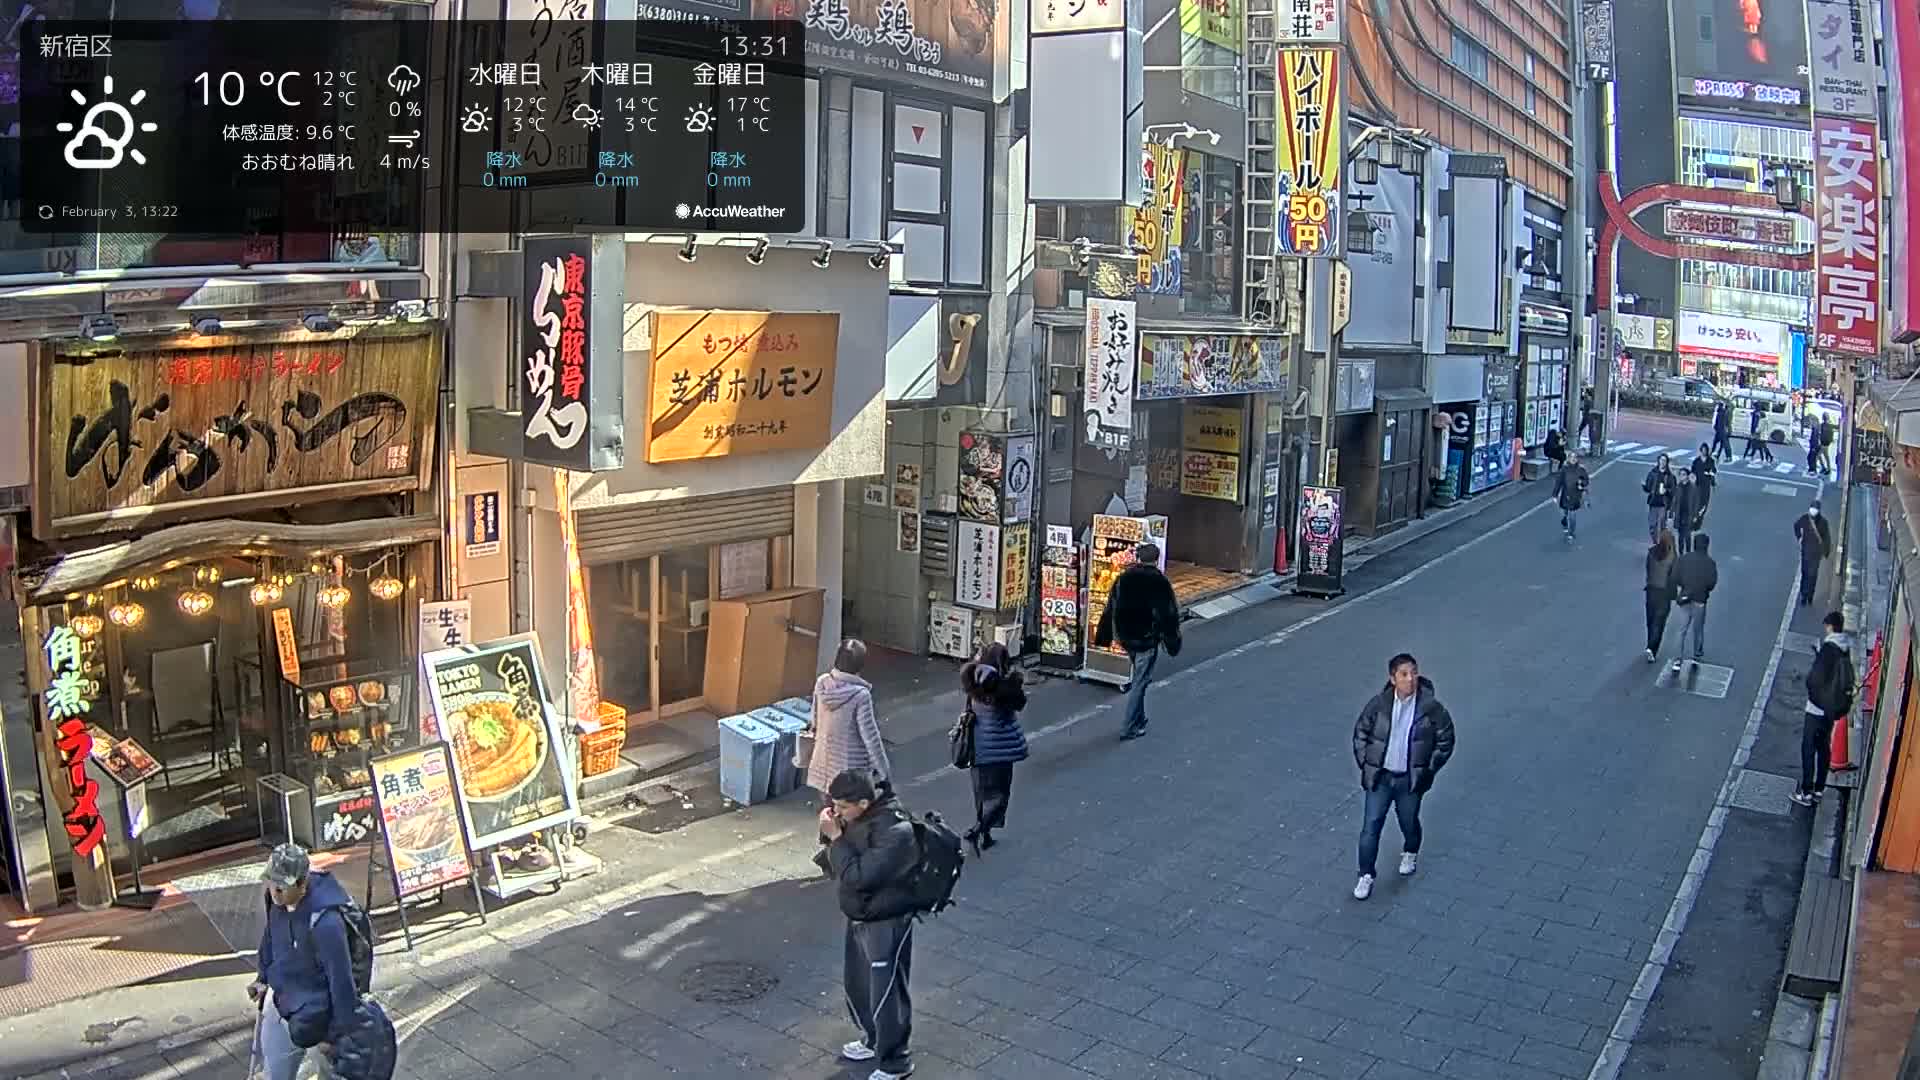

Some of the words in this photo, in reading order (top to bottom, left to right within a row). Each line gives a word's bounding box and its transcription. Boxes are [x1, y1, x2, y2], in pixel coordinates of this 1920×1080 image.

[1589, 63, 1610, 79] 7F
[1832, 97, 1856, 112] 3F
[1296, 51, 1322, 191] ハイボール
[1289, 196, 1328, 222] 50
[1295, 224, 1319, 251] 円
[1820, 126, 1876, 330] 安楽亭
[559, 252, 586, 401] 東京豚骨
[1818, 333, 1837, 348] 2F
[668, 366, 824, 406] 芝浦ホルモン
[1104, 432, 1130, 446] B1F
[1043, 599, 1076, 616] 980
[44, 625, 92, 721] 角煮
[436, 663, 480, 684] TOKYO
[439, 676, 482, 697] RAMEN
[54, 717, 106, 857] ラーメン
[380, 767, 425, 800] 角煮
